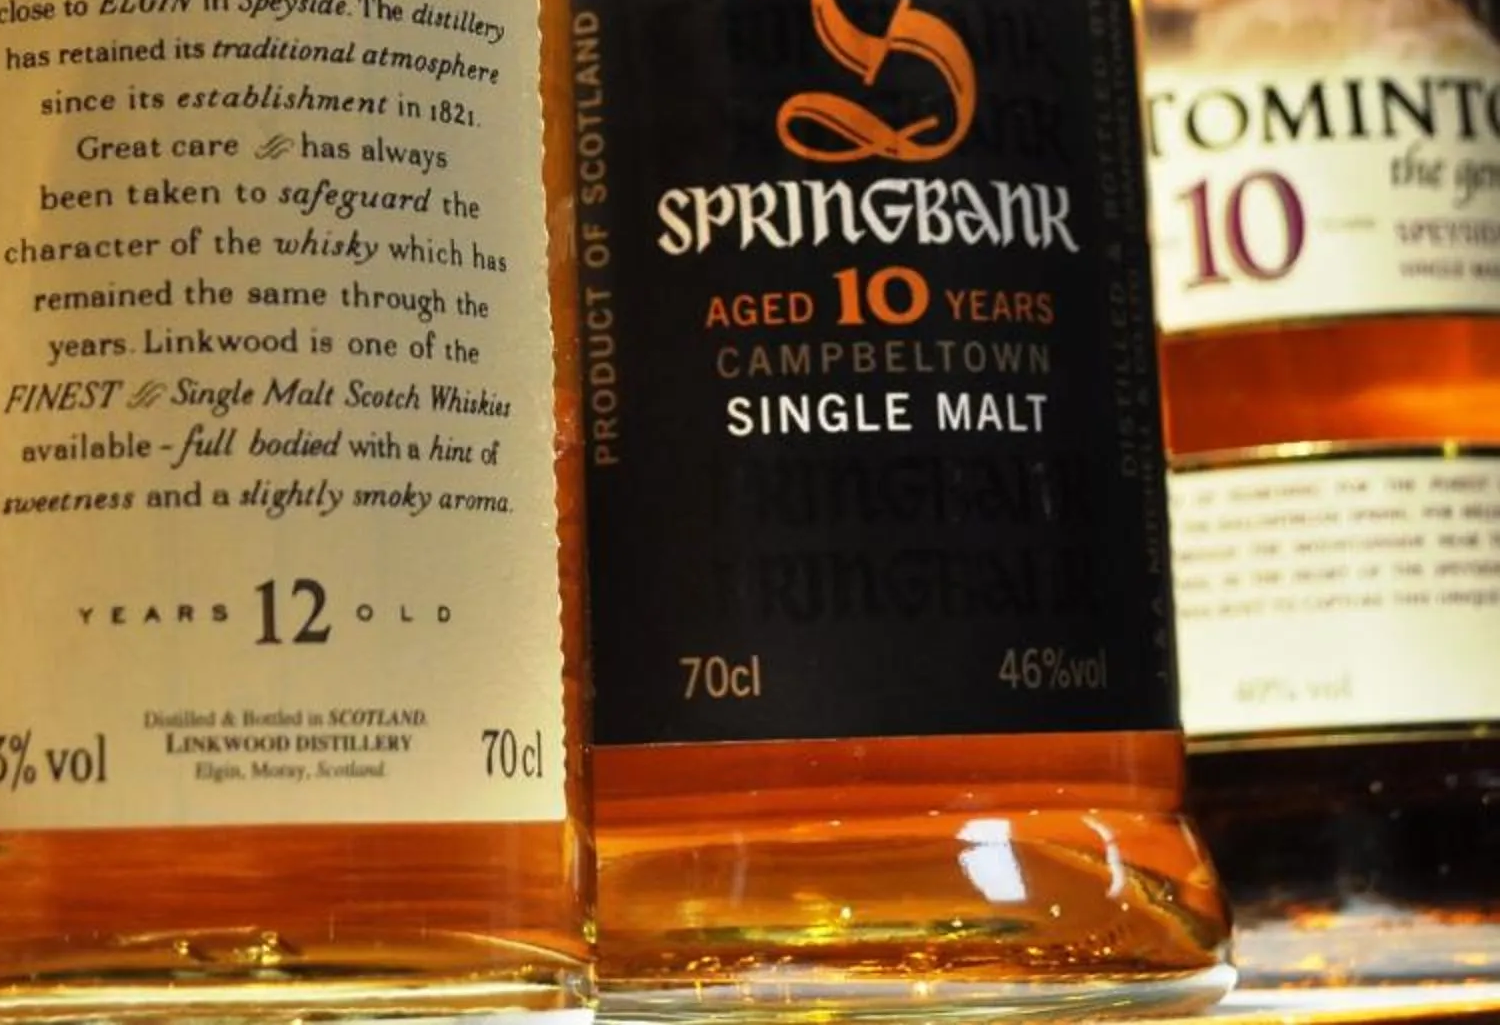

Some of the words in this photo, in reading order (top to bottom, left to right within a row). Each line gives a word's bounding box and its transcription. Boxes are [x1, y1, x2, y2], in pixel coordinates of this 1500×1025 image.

[64, 0, 88, 16] to
[412, 3, 504, 44] distillery
[6, 48, 50, 70] has
[60, 39, 165, 64] retained
[176, 43, 204, 59] its
[213, 37, 355, 63] traditional
[362, 47, 498, 84] atmosphere
[42, 95, 115, 115] since
[130, 92, 164, 109] its
[177, 84, 386, 114] establishment
[399, 101, 420, 118] in
[430, 100, 480, 126] 1821.
[574, 11, 606, 206] SCOTLAND
[1146, 76, 1500, 159] TOMINT
[77, 136, 160, 160] Great
[172, 140, 238, 156] care
[302, 132, 350, 159] has
[362, 137, 447, 174] always
[41, 185, 112, 210] been
[128, 179, 219, 205] taken
[236, 184, 266, 203] to
[279, 180, 431, 219] safeguard
[443, 192, 479, 219] the
[657, 178, 1079, 255] SPRINGBANK
[4, 239, 160, 264] character
[171, 227, 202, 255] of
[215, 228, 260, 254] the
[274, 228, 378, 265] whisky
[389, 234, 462, 266] which
[473, 242, 506, 272] has
[583, 228, 610, 270] OF
[1173, 169, 1307, 293] 10
[34, 280, 171, 311] remained
[185, 278, 232, 305] the
[248, 288, 326, 305] same
[342, 281, 445, 322] through
[457, 292, 488, 318] the
[705, 291, 814, 328] AGED
[832, 266, 930, 327] 10
[945, 289, 1054, 325] YEARS
[48, 339, 135, 366] years.
[145, 328, 297, 354] Linkwood
[311, 337, 332, 353] is
[348, 338, 396, 356] one
[410, 331, 435, 359] of
[446, 339, 479, 363] the
[717, 340, 1050, 378] CAMPBELTOWN
[4, 381, 123, 414] FINEST
[171, 378, 254, 416] Single
[264, 379, 334, 406] Malt
[345, 380, 419, 410] Scotch
[432, 385, 510, 417] Whiskies
[585, 287, 618, 466] PRODUCT
[726, 393, 912, 436] SINGLE
[938, 394, 1047, 433] MALT
[22, 431, 151, 462] available
[249, 428, 342, 456] bodied
[349, 432, 400, 459] with
[408, 444, 420, 460] a
[430, 435, 472, 463] hint
[481, 440, 500, 465] of
[3, 493, 133, 515] sweetness
[147, 481, 201, 508] and
[213, 491, 229, 506] a
[240, 479, 343, 518] slightly
[353, 482, 431, 517] smoky
[439, 494, 514, 513] aroma.
[79, 604, 228, 624] YEARS
[254, 578, 331, 644] 12
[356, 604, 451, 623] OLD
[680, 655, 761, 699] 70cl
[144, 711, 216, 728] Distilled
[222, 713, 236, 727] &
[244, 710, 302, 727] Bottled
[308, 711, 323, 727] in
[46, 734, 106, 782] vol
[166, 732, 290, 754] LINKWOOD
[296, 735, 412, 753] DISTILLERY
